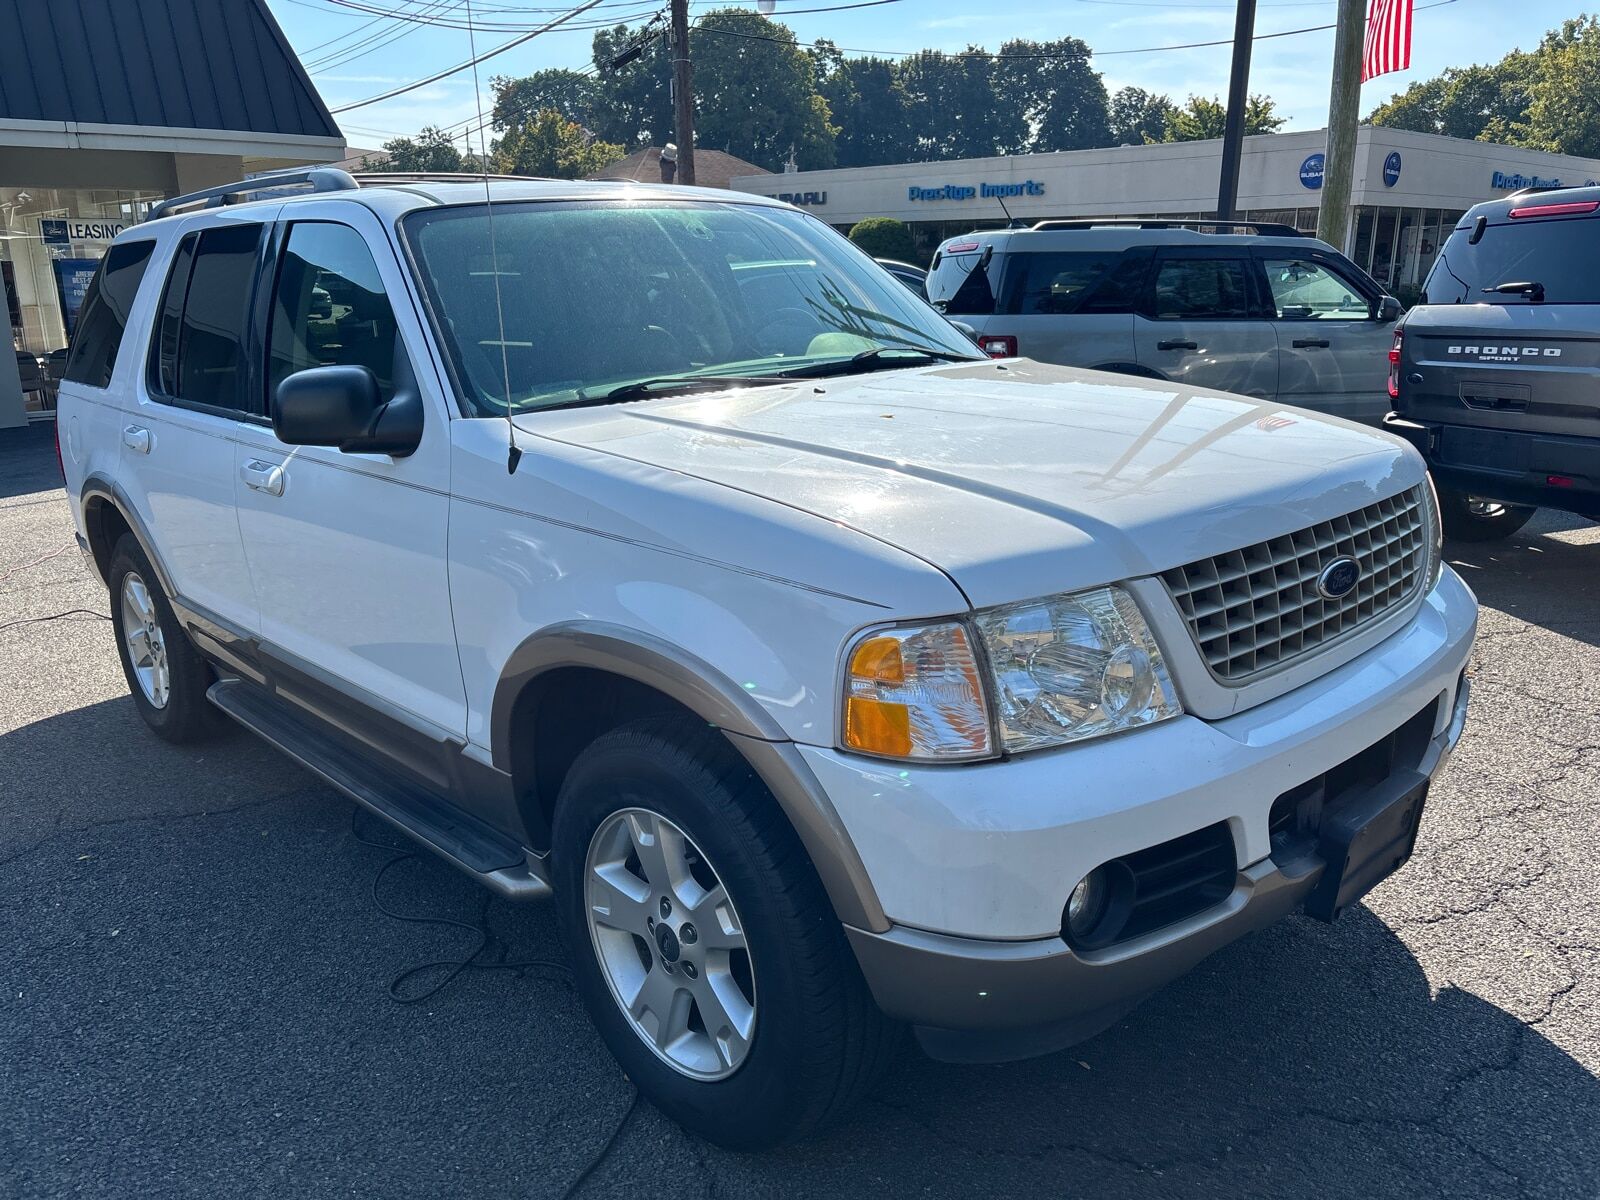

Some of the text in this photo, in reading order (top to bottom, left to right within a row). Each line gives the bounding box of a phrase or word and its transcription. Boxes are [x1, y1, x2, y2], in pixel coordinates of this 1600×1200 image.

[908, 180, 1045, 200] Prestige Imports
[1447, 346, 1561, 356] BRONCO
